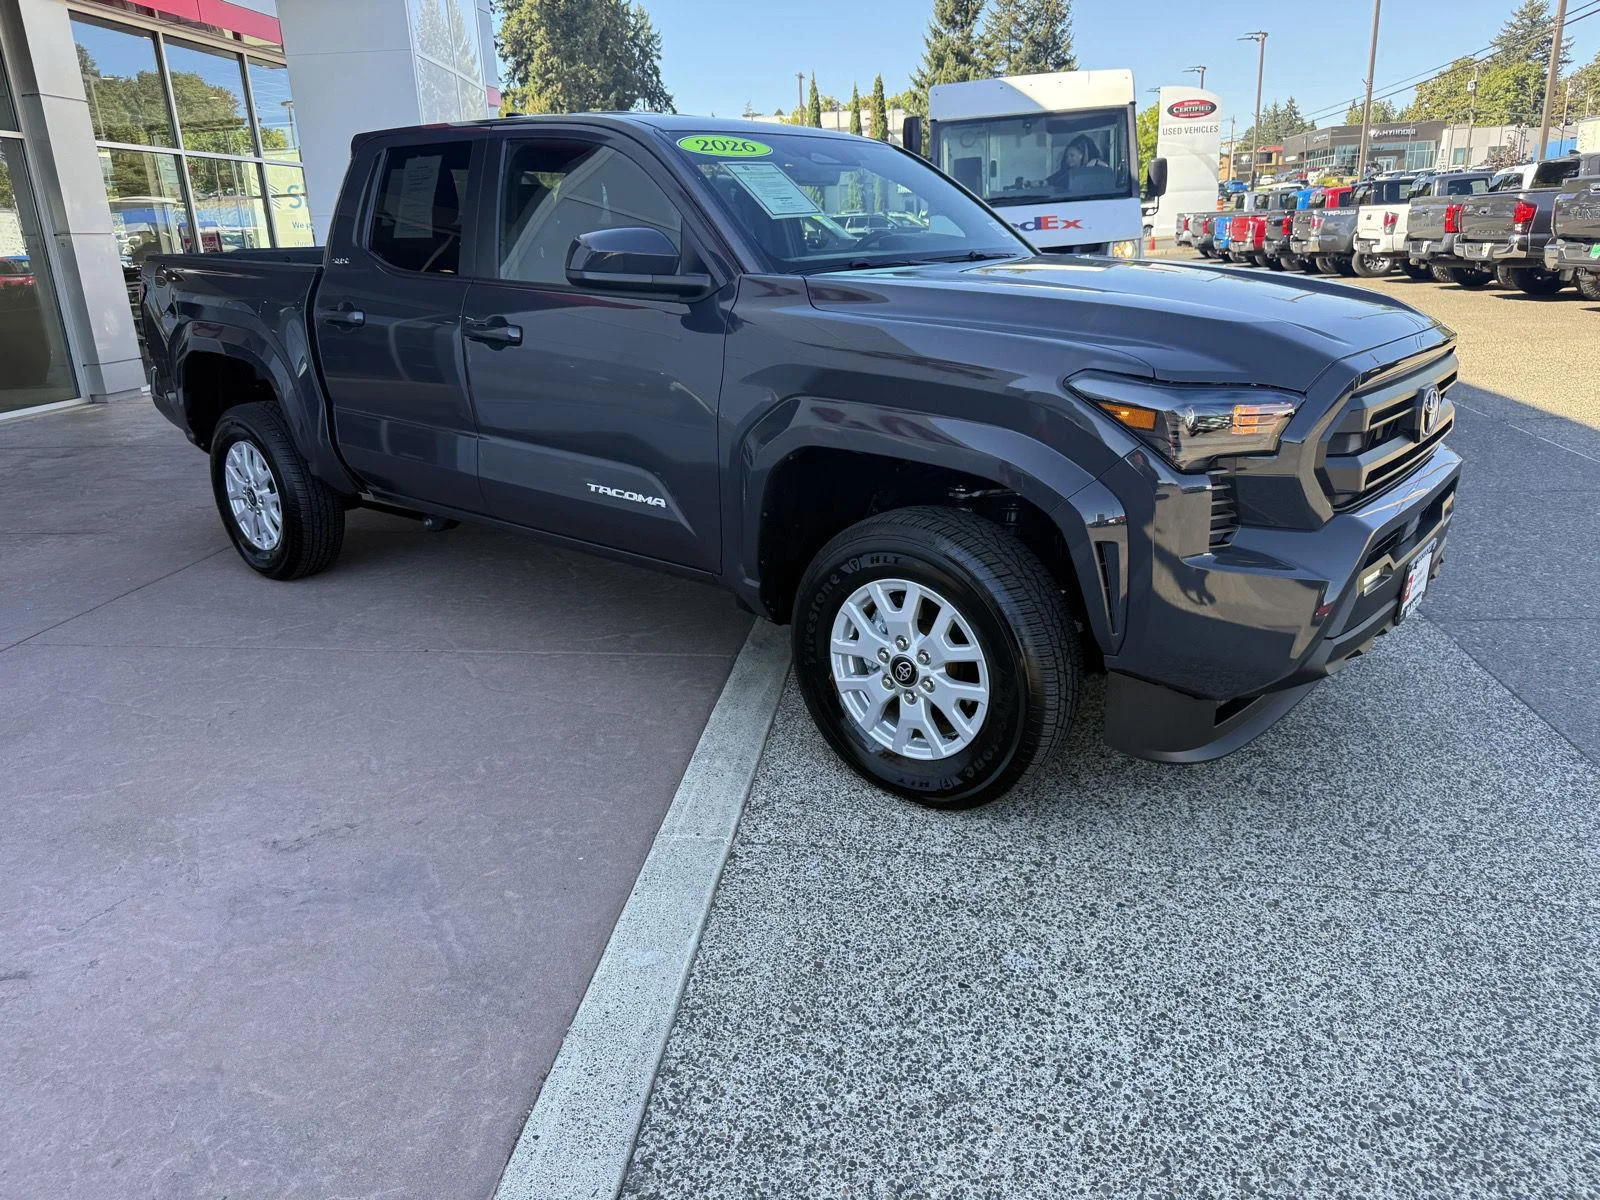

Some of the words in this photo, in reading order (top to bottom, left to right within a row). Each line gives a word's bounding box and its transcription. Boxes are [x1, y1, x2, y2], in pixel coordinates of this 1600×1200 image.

[1173, 105, 1211, 114] CERTIFIED
[1162, 128, 1182, 136] USED
[1184, 125, 1219, 135] VEHICLES
[695, 139, 757, 152] 2026
[292, 221, 304, 229] We
[1010, 215, 1084, 232] dEx
[586, 482, 666, 508] TACOMA
